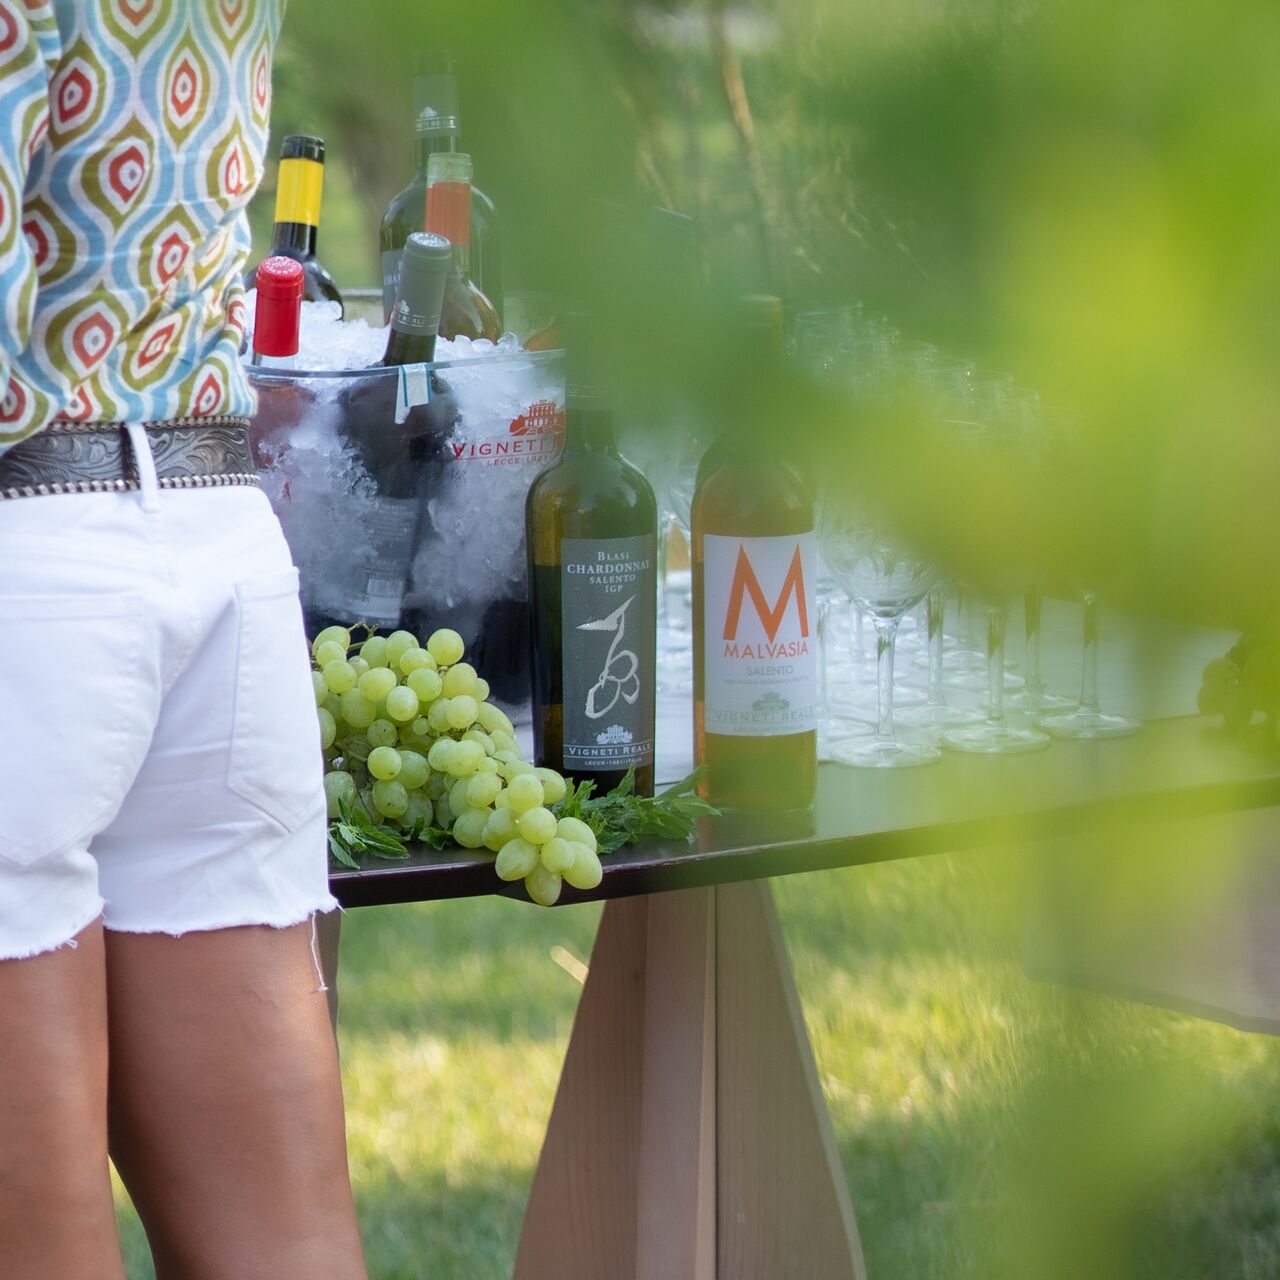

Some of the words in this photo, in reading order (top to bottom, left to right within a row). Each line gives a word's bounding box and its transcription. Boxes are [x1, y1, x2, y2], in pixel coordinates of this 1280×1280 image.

[451, 439, 545, 458] VIGNETI
[566, 559, 650, 574] CHARDONNAY
[589, 574, 636, 584] SALENTO
[605, 584, 623, 593] IGP
[722, 542, 810, 645] M
[723, 639, 809, 659] MALVASIA
[745, 664, 794, 677] SALENTO
[716, 710, 776, 723] VIGNETI
[568, 747, 618, 756] VIGNETI
[622, 743, 650, 755] REALE
